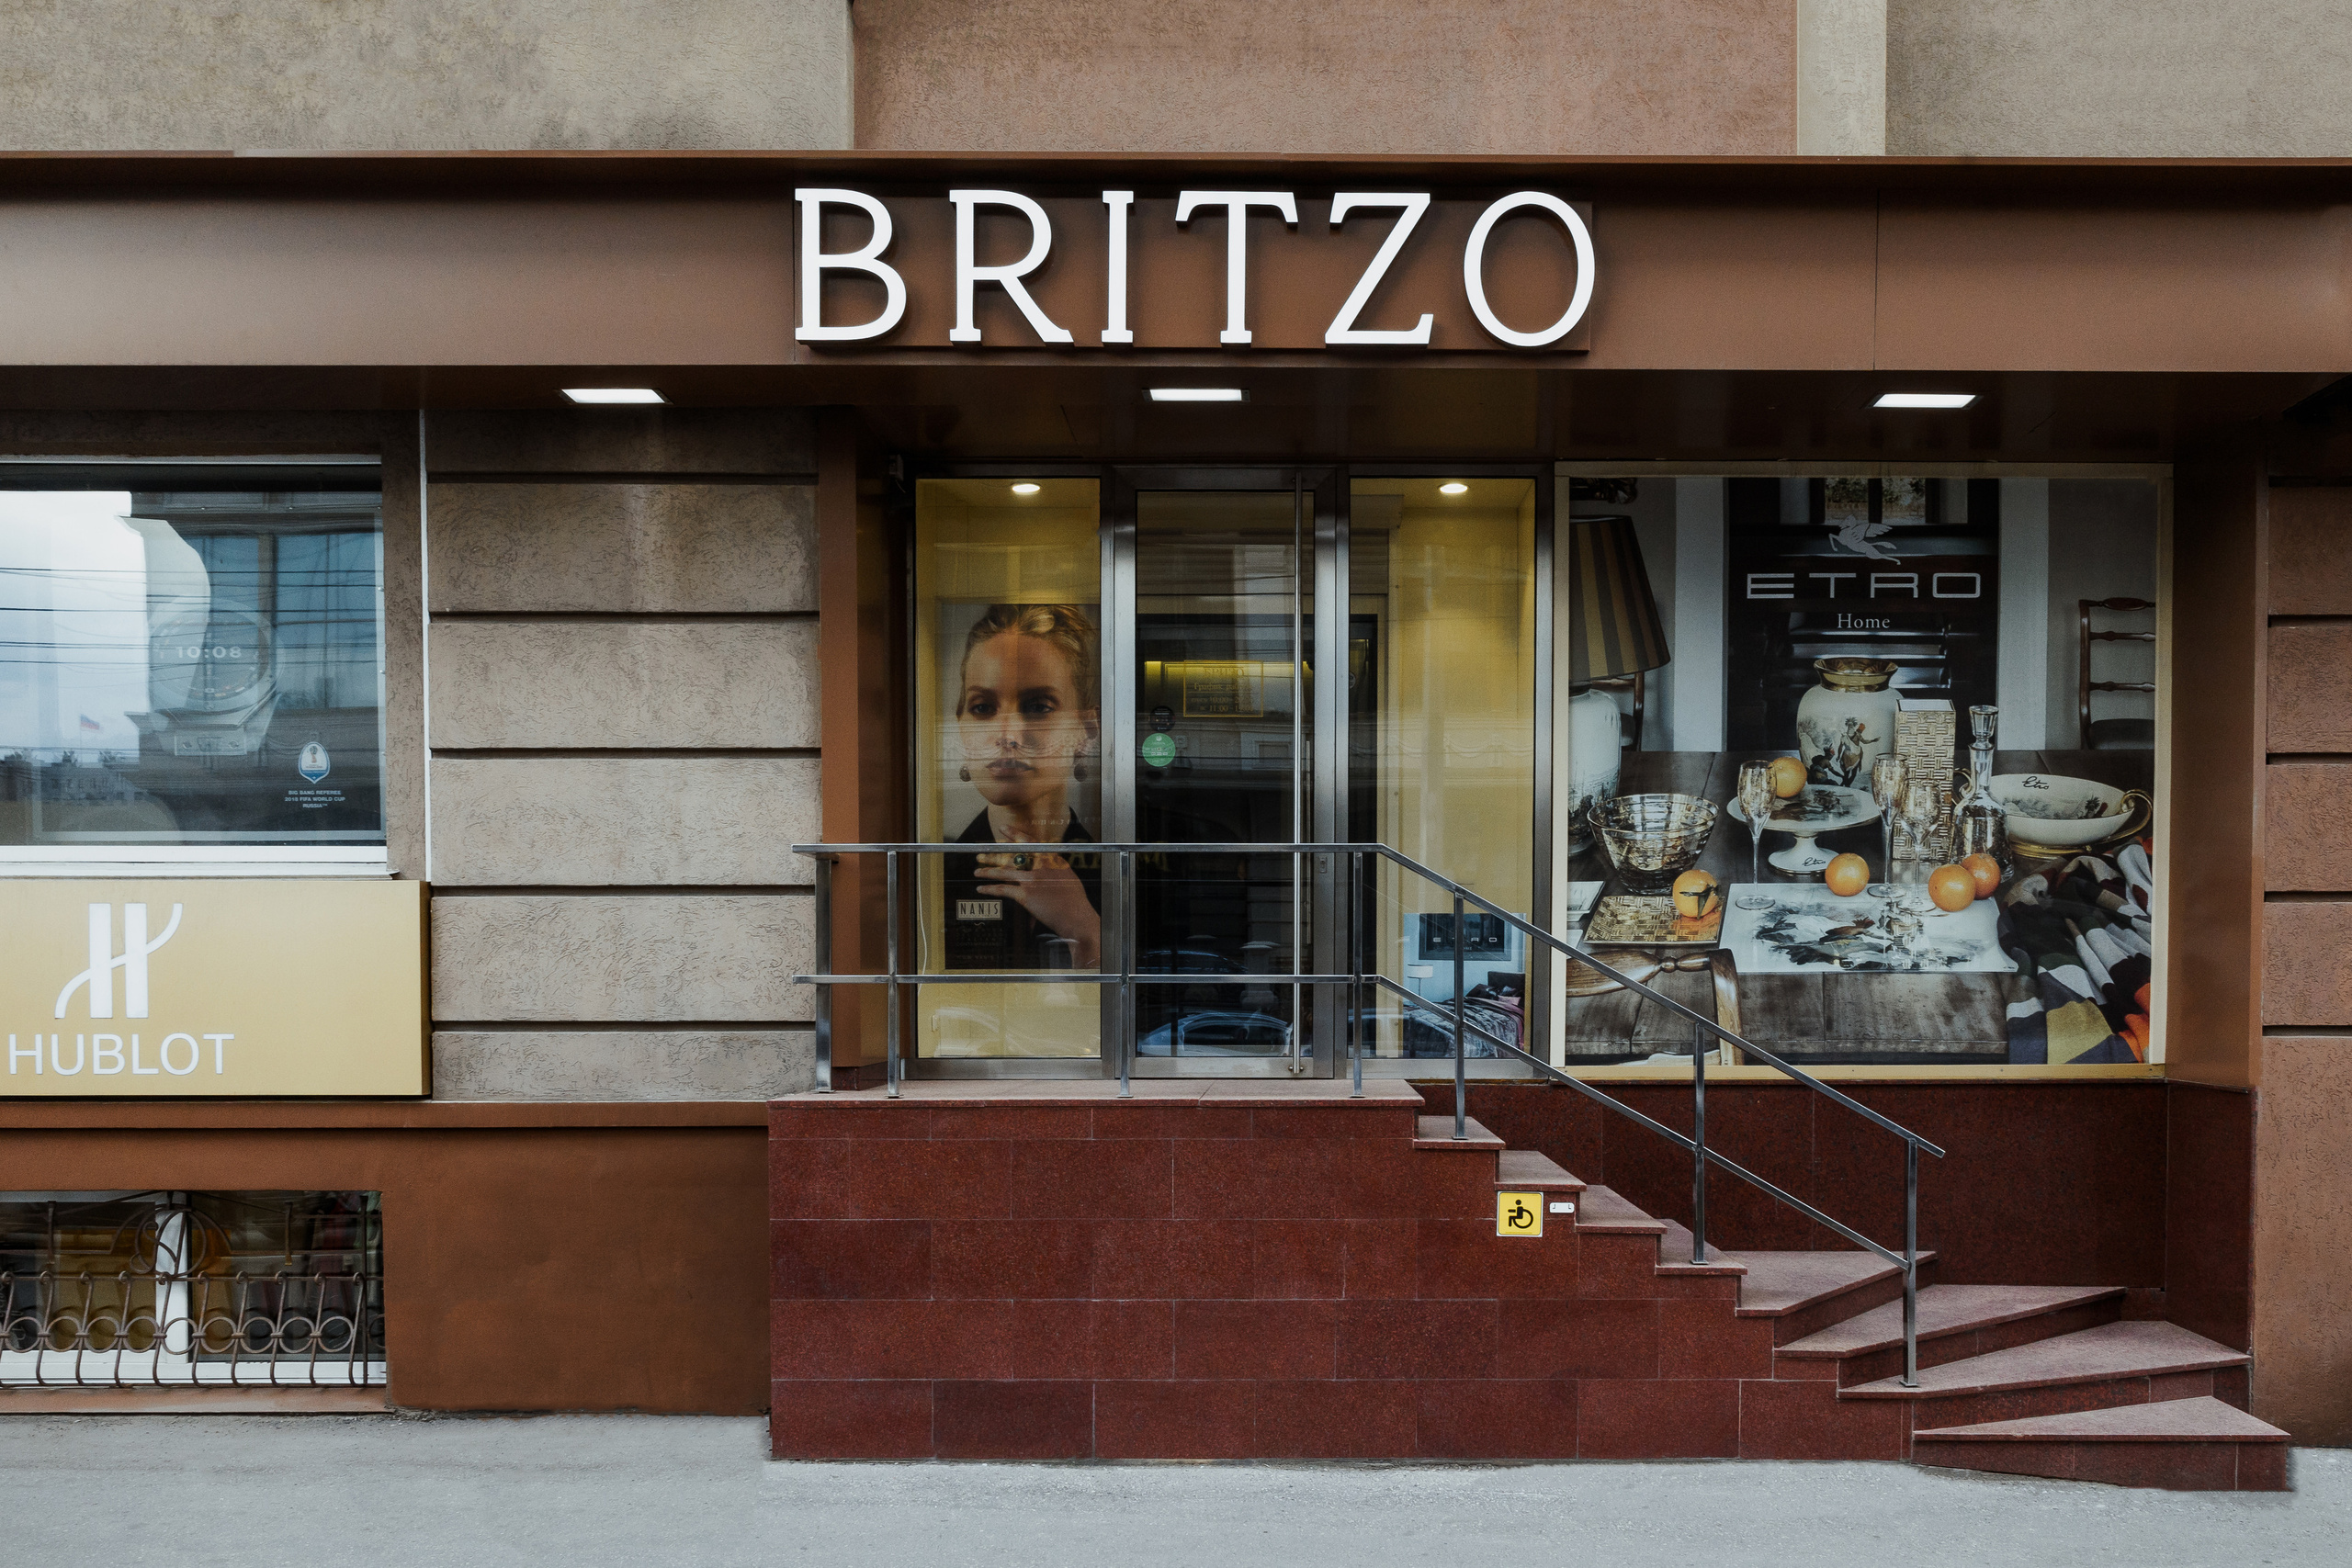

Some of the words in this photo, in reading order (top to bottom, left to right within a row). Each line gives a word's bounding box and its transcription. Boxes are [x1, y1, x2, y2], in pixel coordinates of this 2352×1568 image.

[795, 187, 1596, 347] BRITZO
[1747, 572, 1981, 598] ETRO
[1838, 613, 1891, 629] Home
[175, 646, 242, 659] 10:08
[2021, 775, 2050, 790] Etro
[960, 902, 999, 915] NANIS
[8, 1032, 235, 1076] HUBLOT
